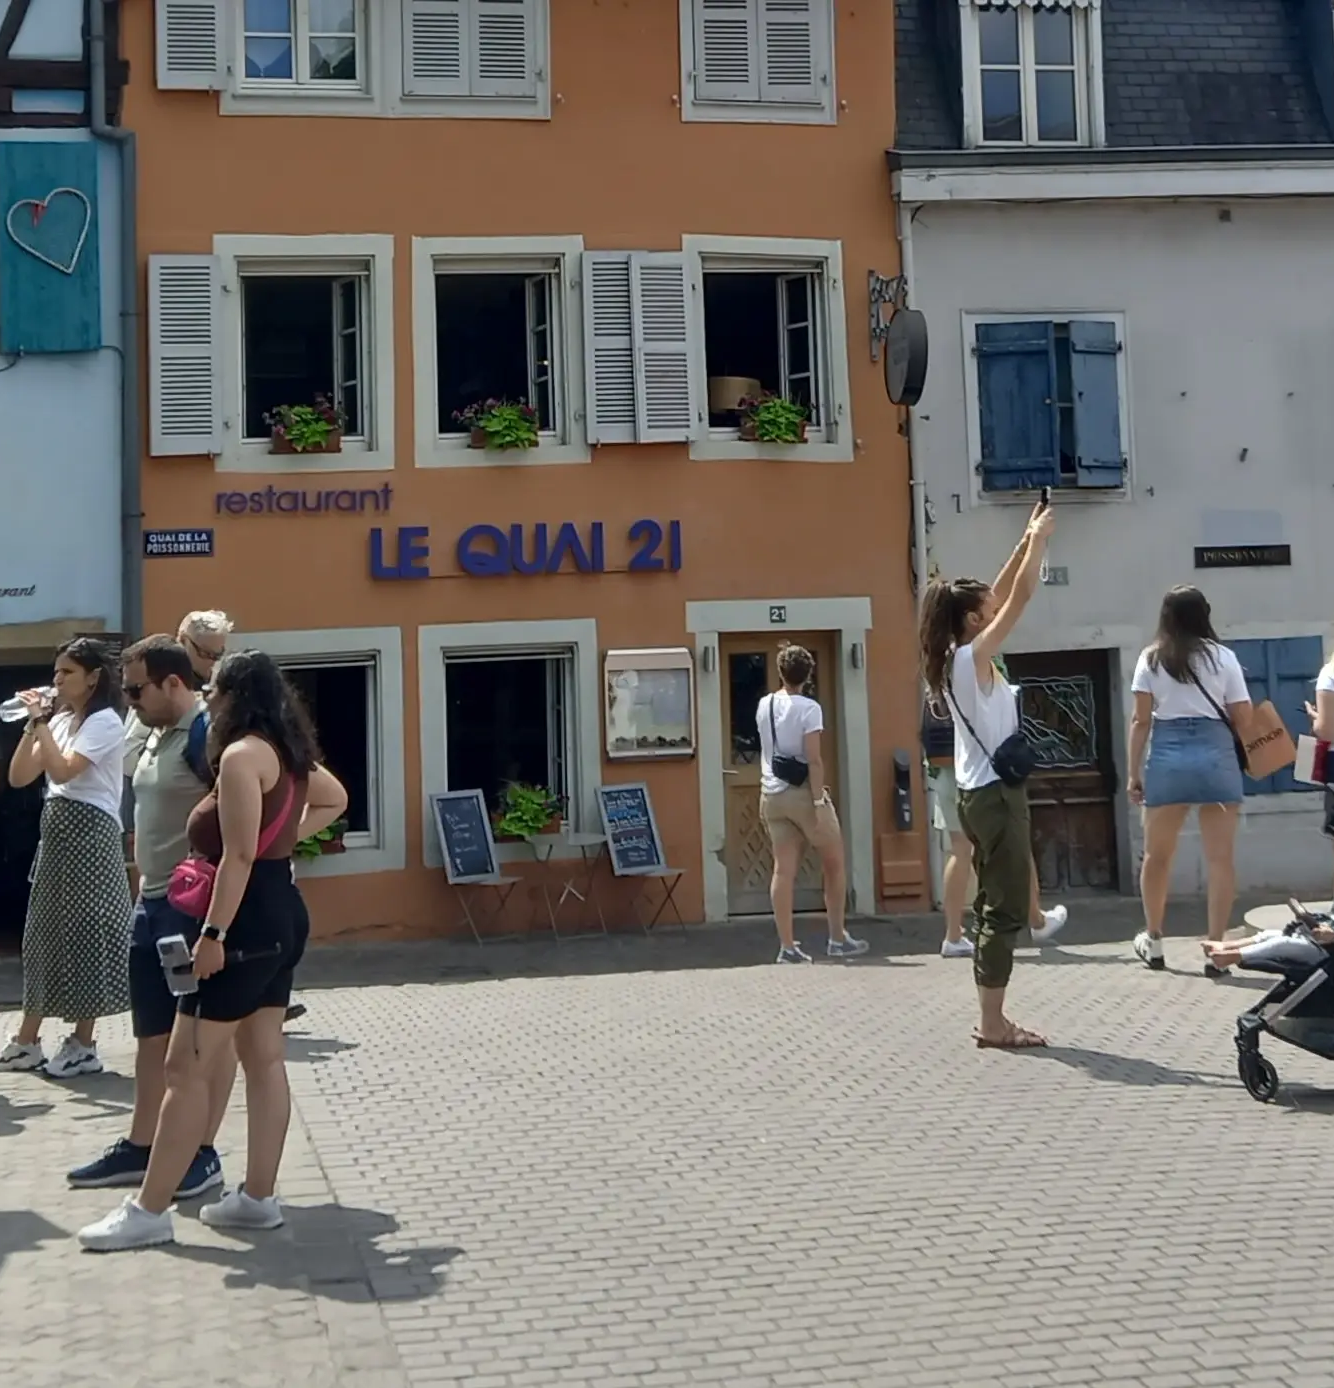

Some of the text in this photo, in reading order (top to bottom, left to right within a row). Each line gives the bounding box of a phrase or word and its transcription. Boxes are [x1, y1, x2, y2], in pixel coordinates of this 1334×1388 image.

[215, 482, 394, 515] restaurant
[149, 532, 208, 542] QUAI DE LA
[147, 542, 211, 553] POISSONNERIE
[370, 519, 681, 579] LE QUAI 21
[771, 608, 785, 620] 21
